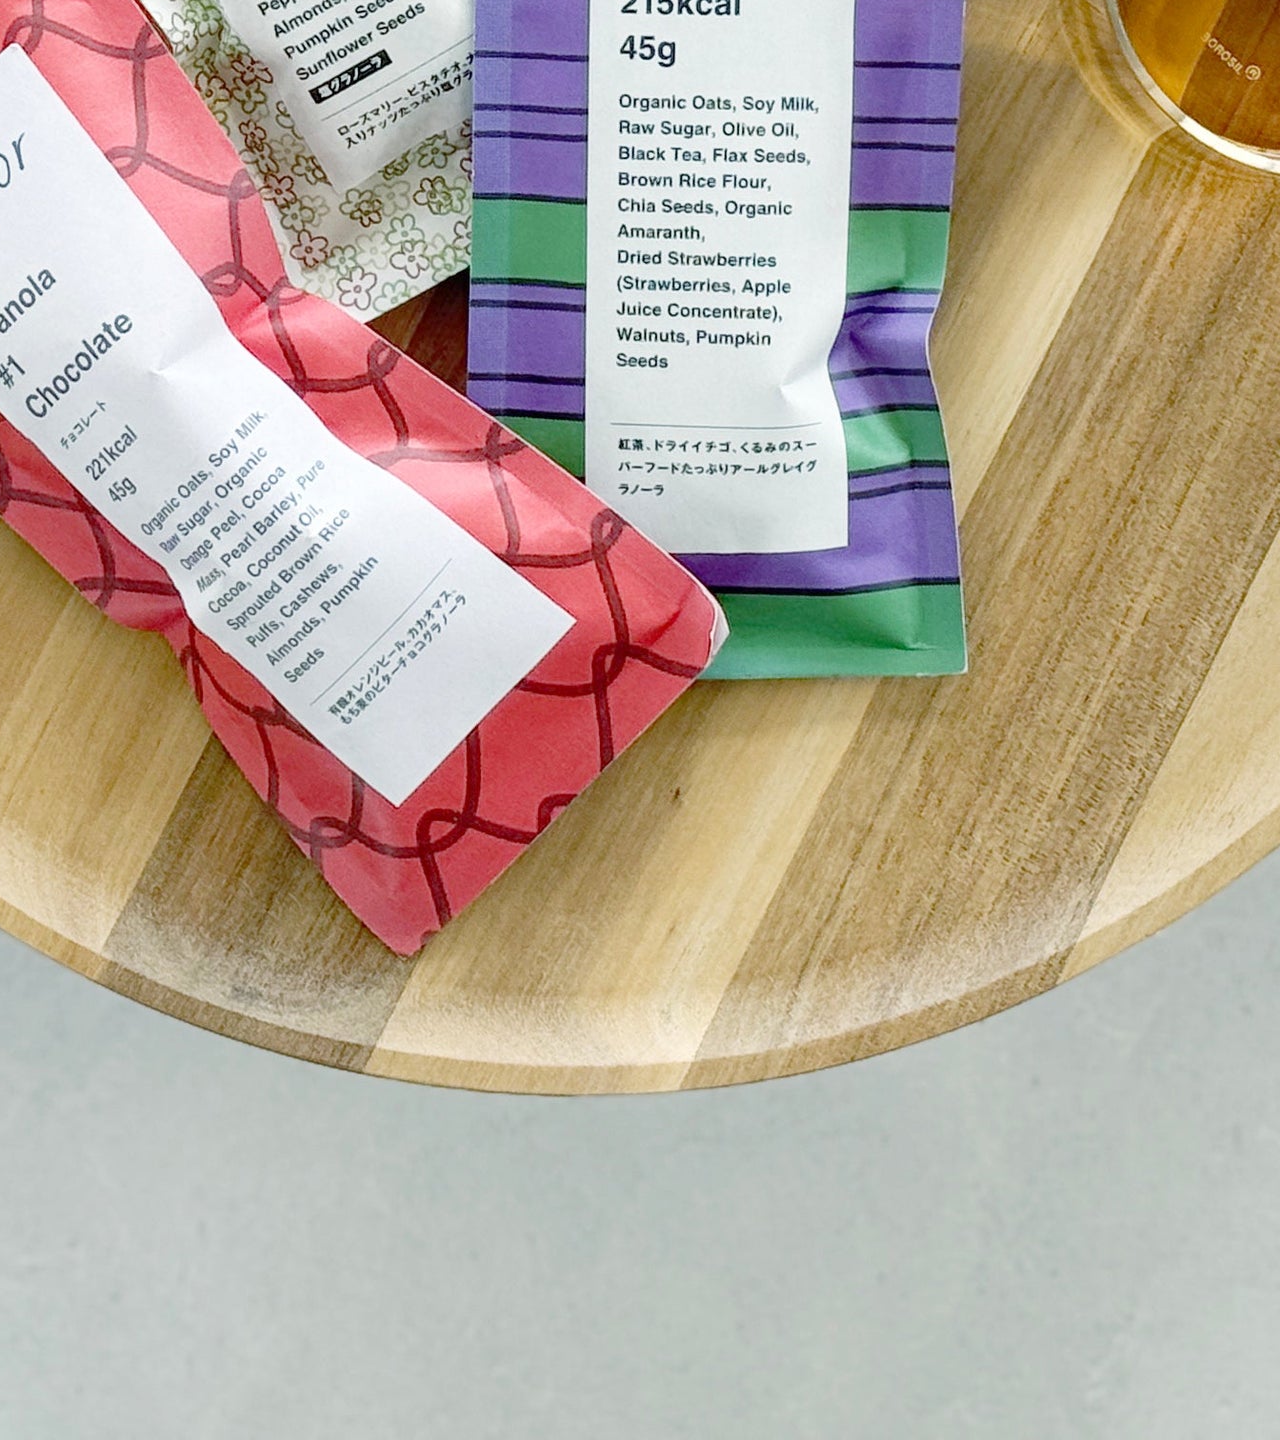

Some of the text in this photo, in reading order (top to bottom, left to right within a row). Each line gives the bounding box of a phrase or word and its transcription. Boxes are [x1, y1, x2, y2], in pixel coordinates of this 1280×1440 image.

[283, 16, 354, 60] Pumpkin
[296, 3, 425, 80] Sunflower Seeds
[620, 35, 676, 68] 45g
[619, 94, 819, 114] Organic Oats, Soy Milk,
[619, 120, 799, 140] Raw Sugar, Olive Oil,
[619, 146, 810, 166] Black Tea, Flax Seeds,
[618, 172, 771, 192] Brown Rice Flour,
[618, 198, 792, 219] Chia Seeds, Organic
[617, 224, 705, 243] Amaranth,
[617, 249, 777, 267] Dried Strawberries
[617, 275, 791, 297] (Strawberries, Apple
[616, 301, 782, 323] Juice Concentrate),
[616, 327, 771, 349] Walnuts, Pumpkin
[25, 314, 132, 418] Chocolate
[616, 353, 668, 368] Seeds
[85, 425, 137, 481] 221kcal
[108, 477, 137, 502] 45g
[141, 411, 269, 535] Organic Oats, Soy Milk,
[159, 448, 267, 553] Raw Sugar, Organic
[180, 467, 286, 570] Orange Peel, Cocoa
[196, 461, 324, 593] Mass, Pearl Barley, Pure
[208, 506, 322, 613] Cocoa, Coconut Oil,
[226, 510, 349, 630] Sprouted Brown Rice
[246, 564, 343, 648] Puffs, Cashews,
[266, 557, 378, 666] Almonds, Pumpkin
[284, 648, 324, 683] Seeds
